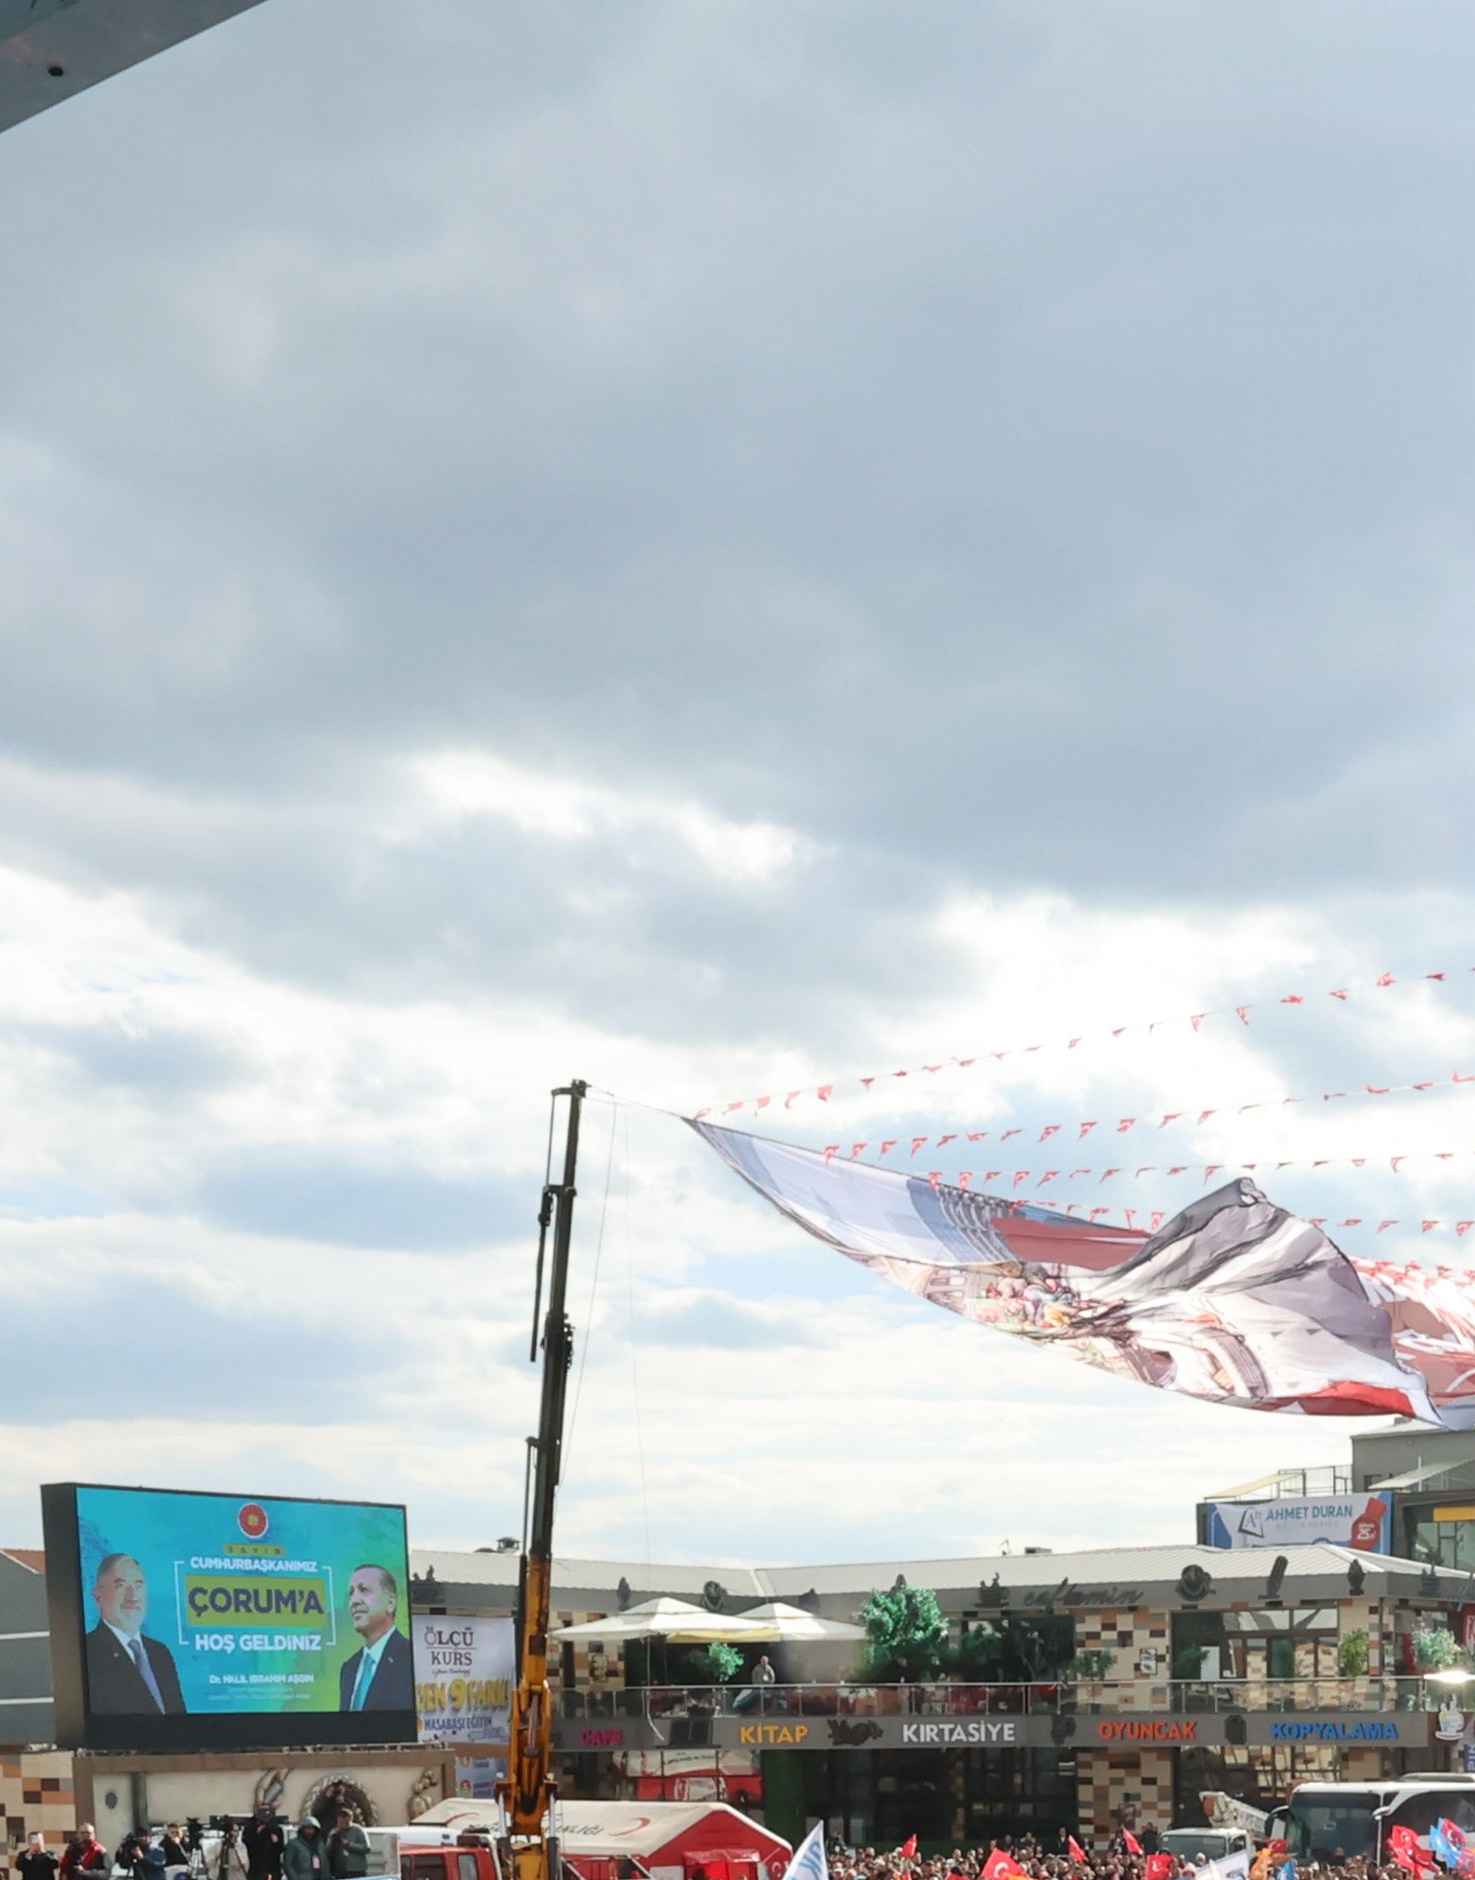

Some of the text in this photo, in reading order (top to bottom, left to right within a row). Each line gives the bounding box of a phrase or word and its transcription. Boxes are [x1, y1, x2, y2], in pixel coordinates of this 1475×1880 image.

[1265, 1505, 1353, 1521] AHMET DURAN
[190, 1556, 318, 1573] CUMHURBAŞKANIMIZ
[188, 1587, 325, 1618] ÇORUM'A
[195, 1634, 236, 1654] HOŞ
[424, 1626, 474, 1650] ÖLÇÜ
[431, 1651, 473, 1666] KURS
[738, 1720, 810, 1745] KİTAP
[901, 1719, 1016, 1744] KIRTASİYE
[1097, 1719, 1198, 1742] OYUNCAK
[1269, 1720, 1399, 1741] KOPYALAMA
